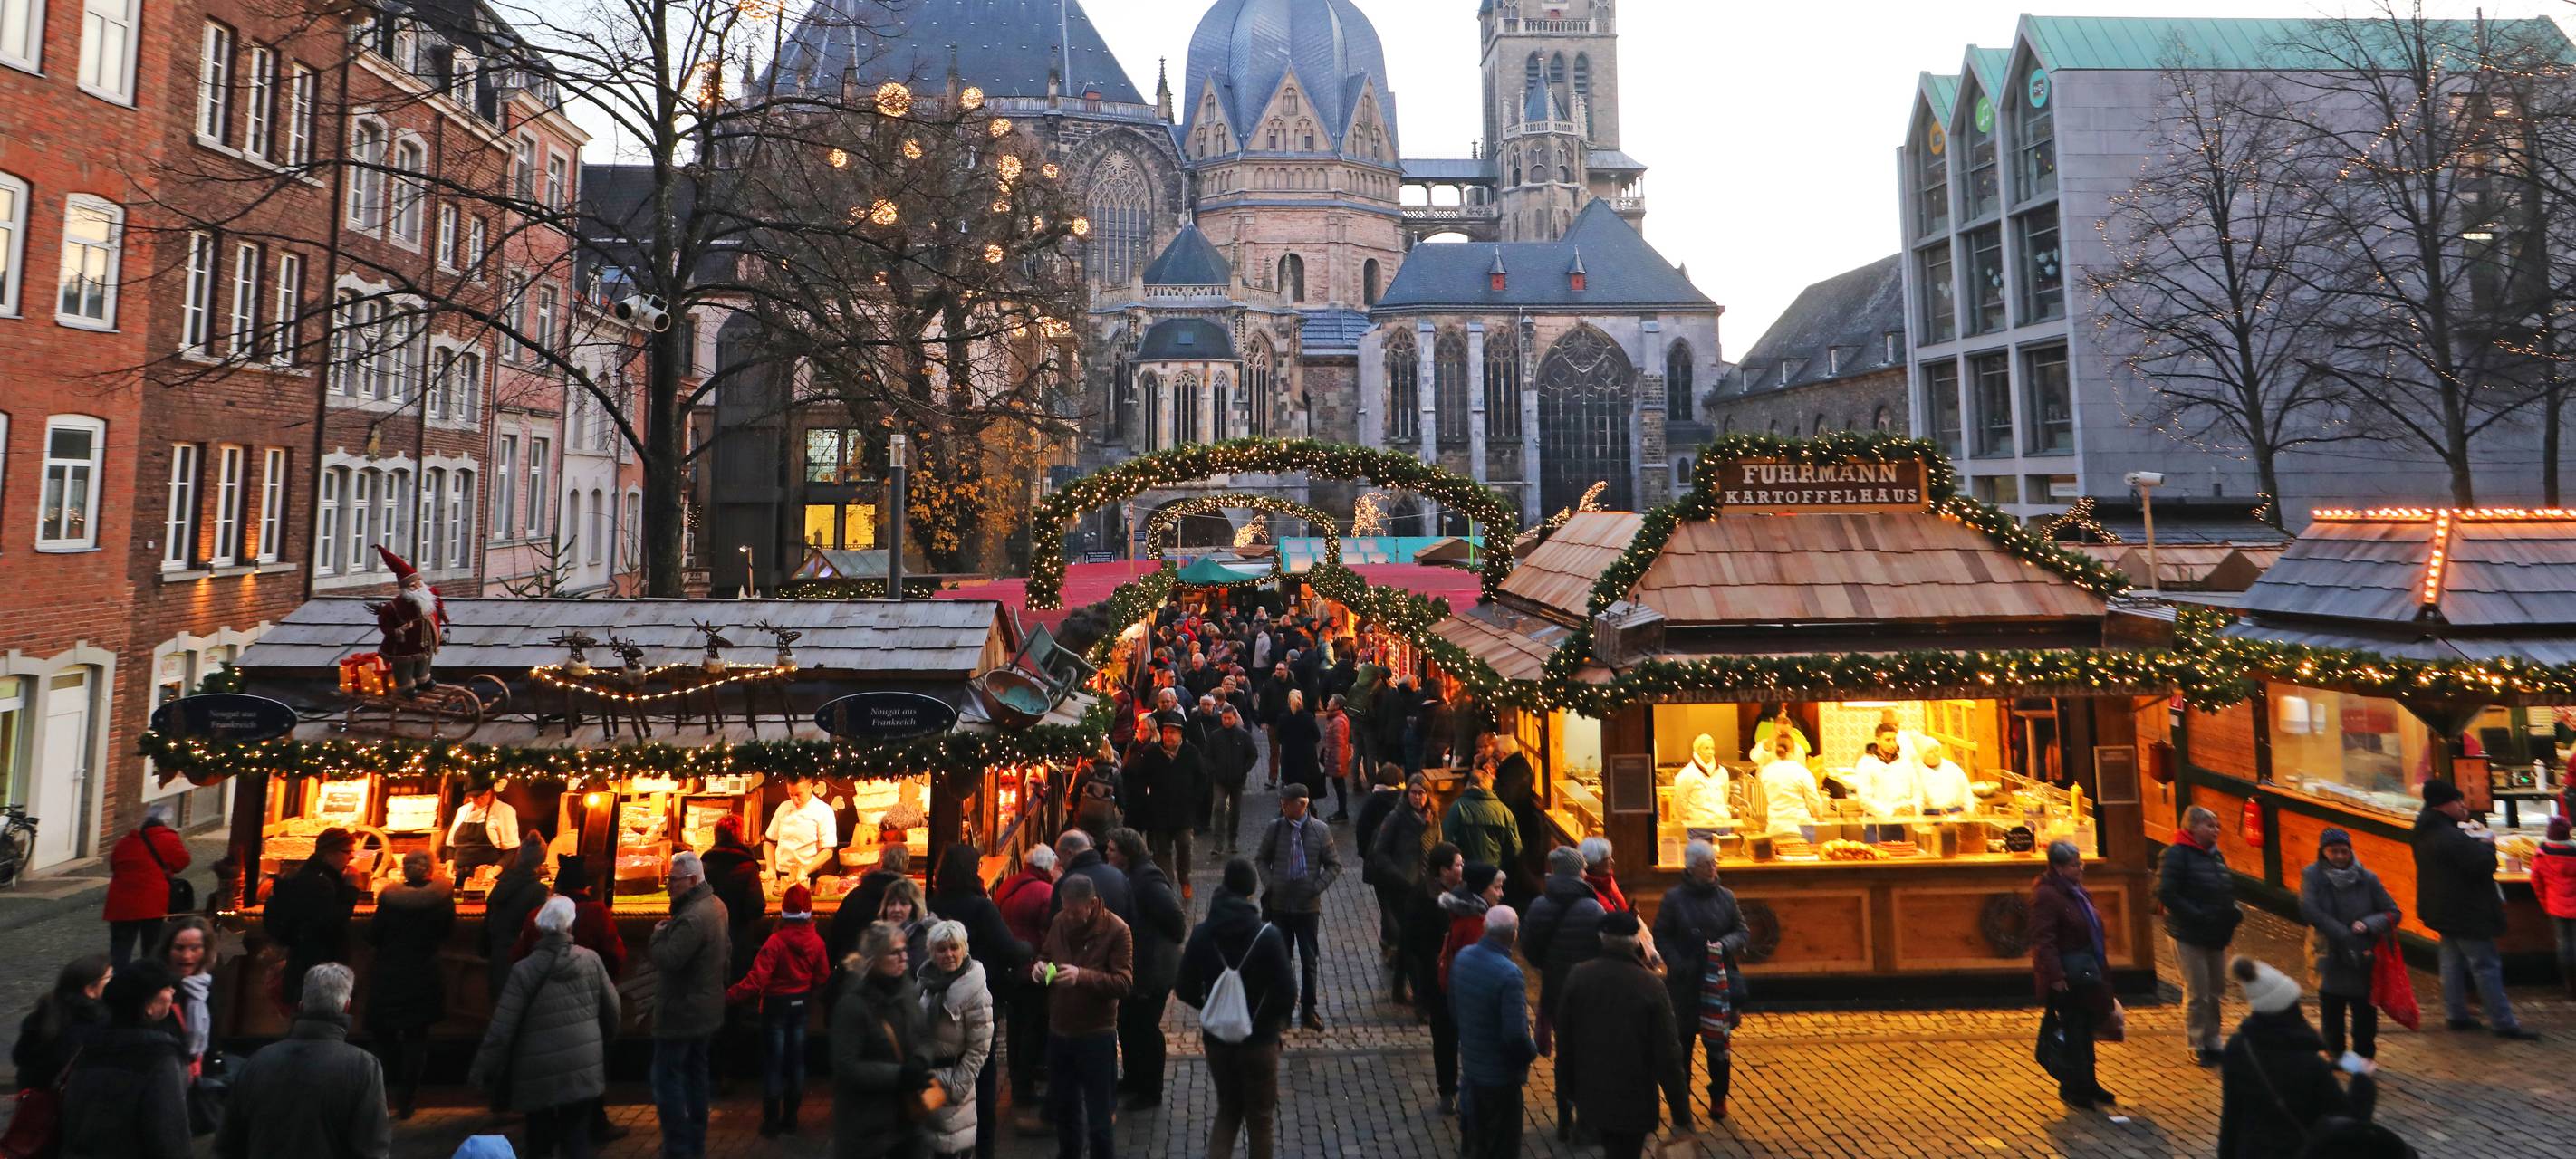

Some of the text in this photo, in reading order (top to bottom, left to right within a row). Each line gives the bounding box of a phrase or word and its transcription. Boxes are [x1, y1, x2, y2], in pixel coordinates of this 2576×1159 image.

[1742, 464, 1898, 484] FUHRMANN
[1725, 488, 1918, 503] KARTOFFELHAUS
[209, 710, 239, 719] Nougat
[871, 708, 900, 717] Nougat
[872, 718, 916, 726] Frankreich
